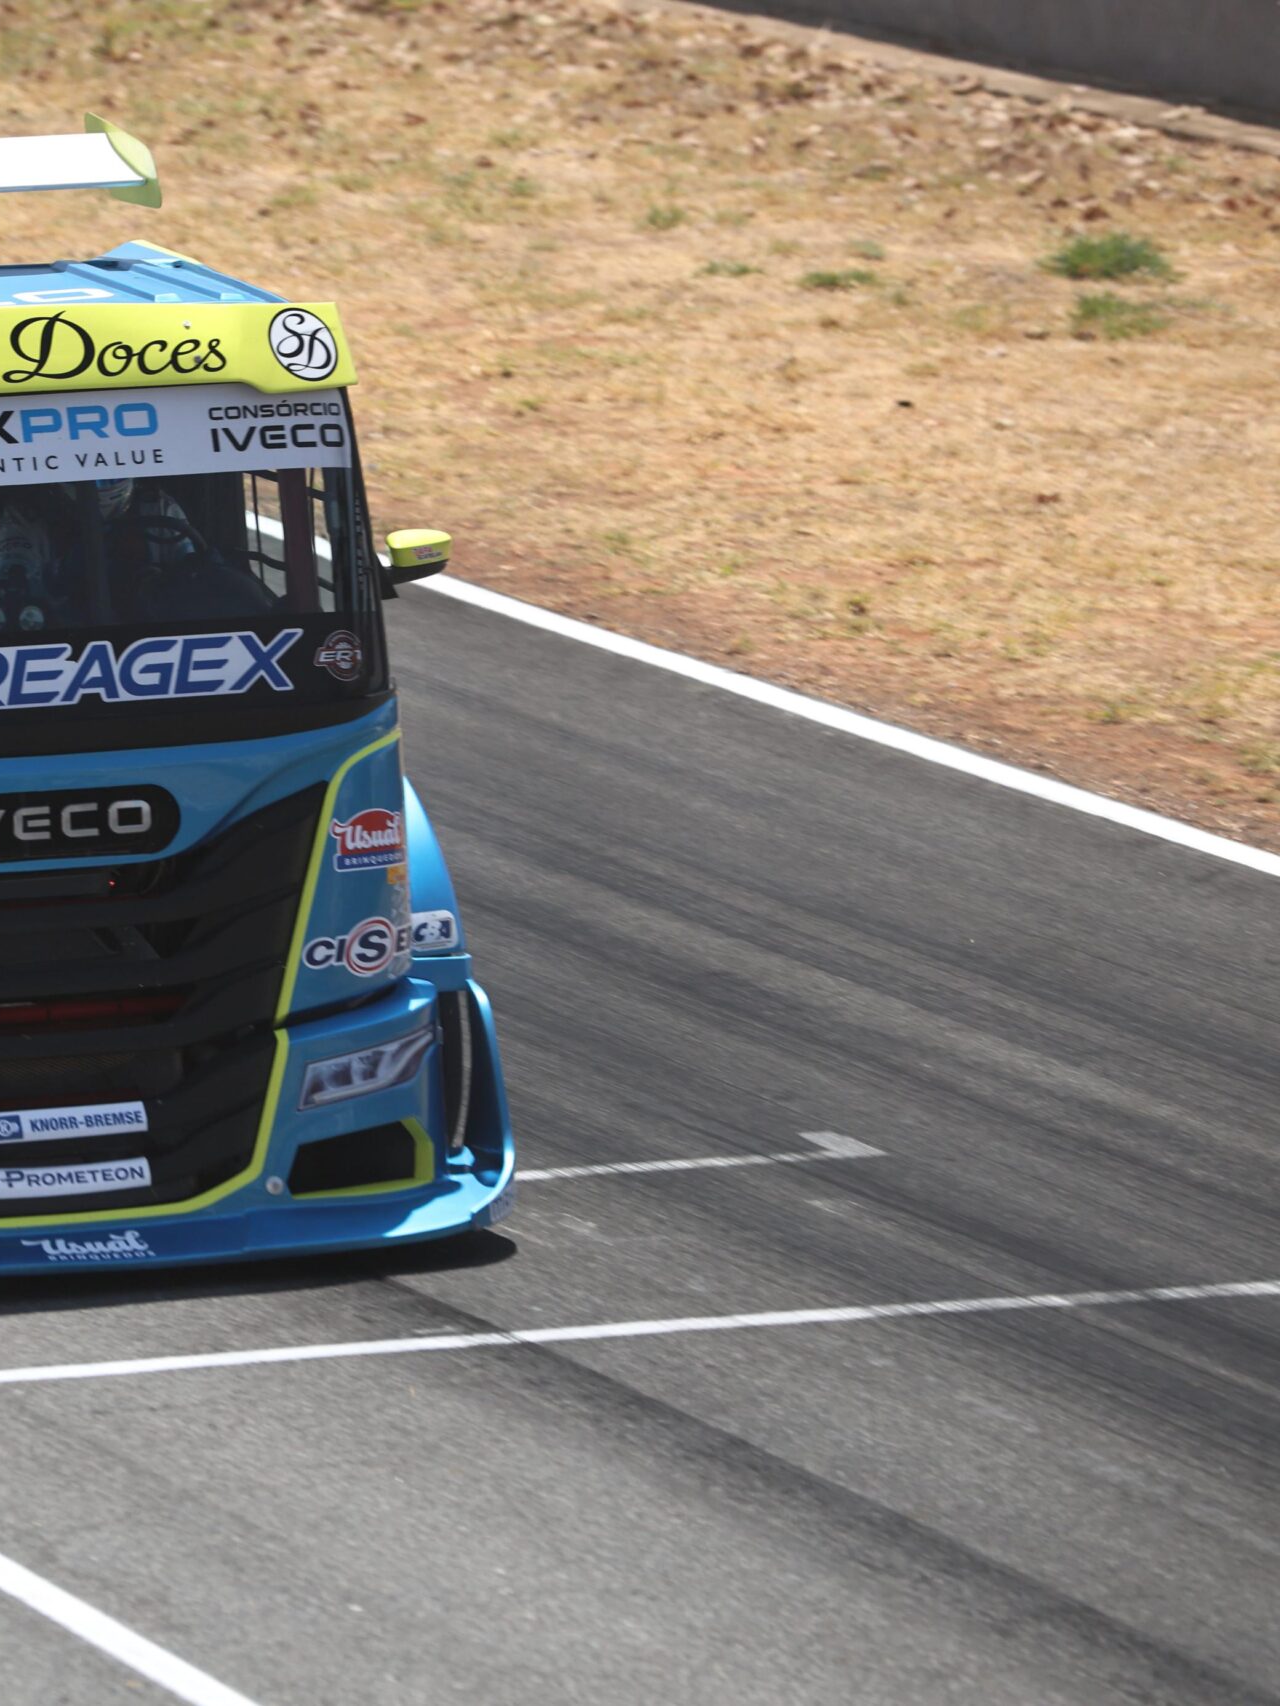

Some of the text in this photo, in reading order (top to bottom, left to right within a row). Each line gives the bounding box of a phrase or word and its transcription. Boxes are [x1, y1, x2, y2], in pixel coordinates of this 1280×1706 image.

[1, 310, 227, 384] Doces
[208, 400, 341, 421] CONSÓRCIO
[210, 423, 346, 453] IVECO
[74, 448, 165, 468] VALUE
[304, 926, 412, 966] CISE
[29, 1110, 144, 1133] KNORR-BREMSE
[0, 1165, 146, 1188] PROMETEON
[20, 1230, 149, 1255] Usual
[47, 1251, 157, 1262] BRINQUEDOS
